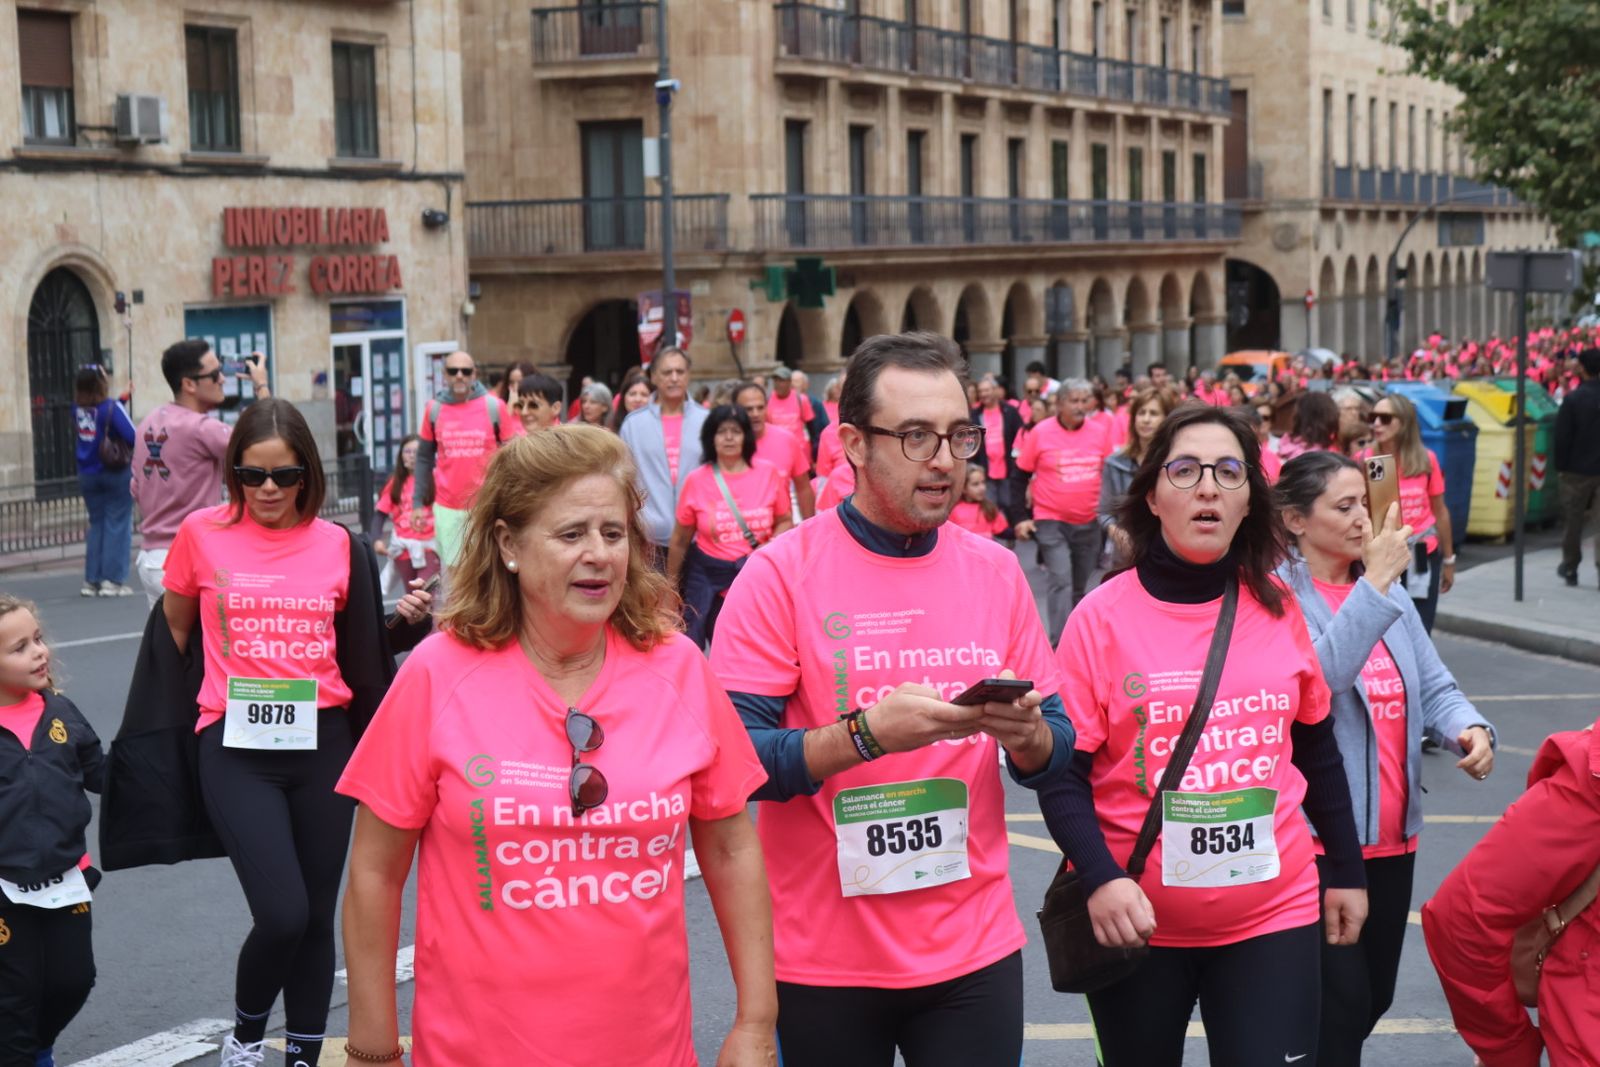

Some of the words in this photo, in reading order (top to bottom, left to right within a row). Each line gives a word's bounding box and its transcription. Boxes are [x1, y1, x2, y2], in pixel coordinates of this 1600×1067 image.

[222, 207, 390, 246] INMOBILIARIA
[211, 255, 296, 297] PEREZ
[309, 254, 403, 294] CORREA
[229, 592, 256, 609] En
[262, 595, 335, 612] marcha
[230, 614, 311, 634] contra
[233, 633, 329, 660] cáncer
[854, 645, 891, 671] En
[900, 641, 1002, 668] marcha
[248, 703, 295, 725] 9878
[1148, 701, 1182, 724] En
[1189, 689, 1290, 719] archa
[1262, 717, 1284, 744] el
[501, 769, 530, 778] contra
[514, 778, 563, 789] Salamanca
[494, 797, 540, 826] En
[553, 791, 685, 826] marcha
[842, 792, 885, 804] Salamanca
[842, 803, 868, 812] contra
[870, 801, 877, 809] el
[878, 799, 906, 808] cáncer
[495, 832, 639, 866] contra
[647, 822, 680, 857] el
[866, 816, 942, 857] 8535
[1190, 822, 1255, 855] 8534
[469, 798, 494, 912] SALAMANCA
[501, 858, 673, 910] cáncer
